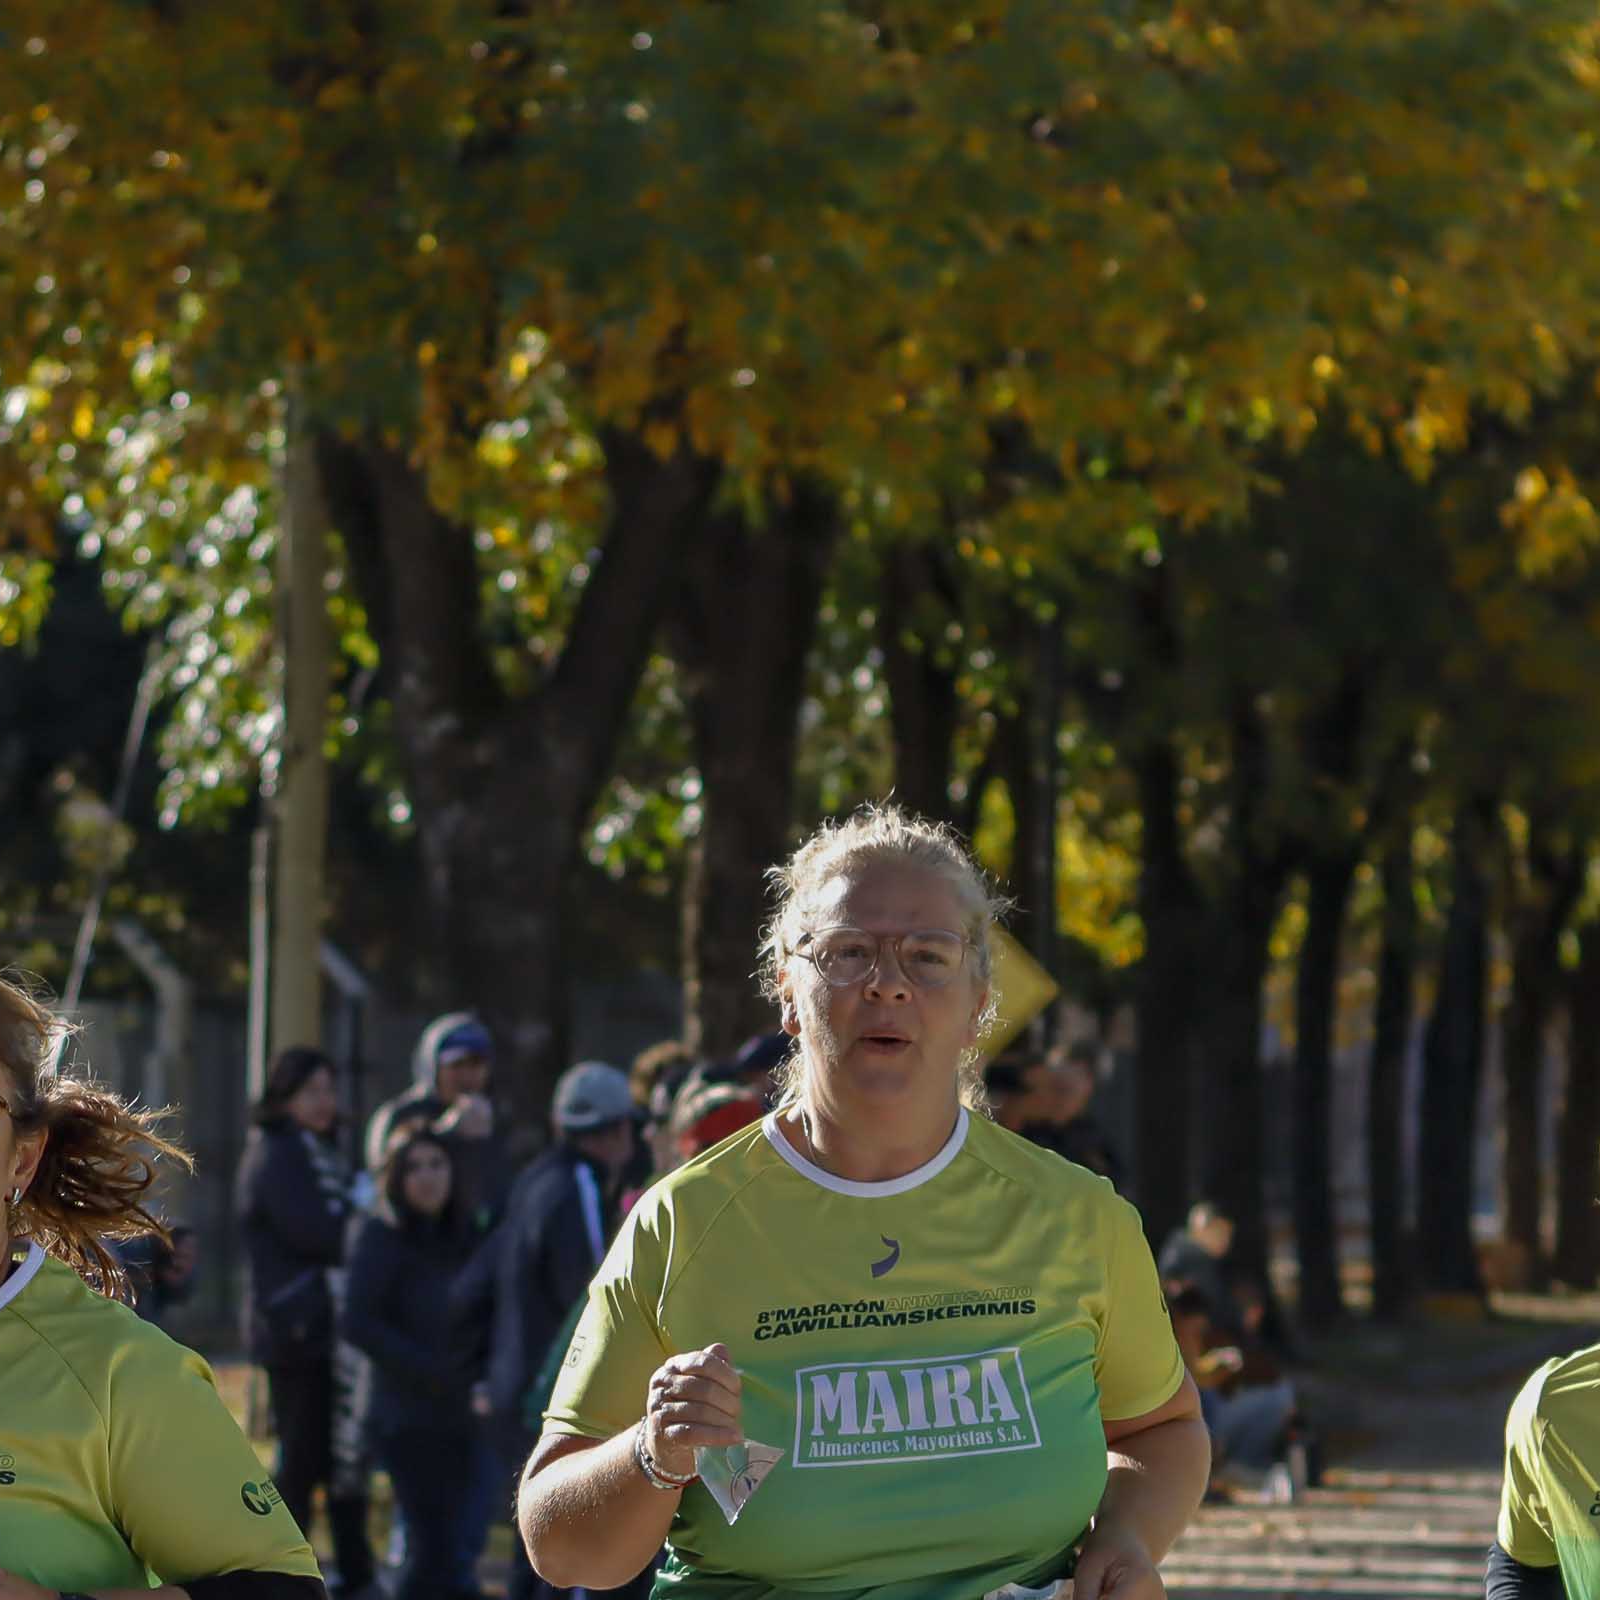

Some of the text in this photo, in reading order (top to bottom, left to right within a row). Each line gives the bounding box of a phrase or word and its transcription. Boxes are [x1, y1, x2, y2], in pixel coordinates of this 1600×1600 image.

[885, 1286, 1033, 1312] ANIVERSARIO
[753, 1299, 1037, 1341] CAWILLIAMSKEMMIS
[810, 1358, 1021, 1437] MAIRA
[808, 1425, 1027, 1458] Almacenes Mayoristas S.A.
